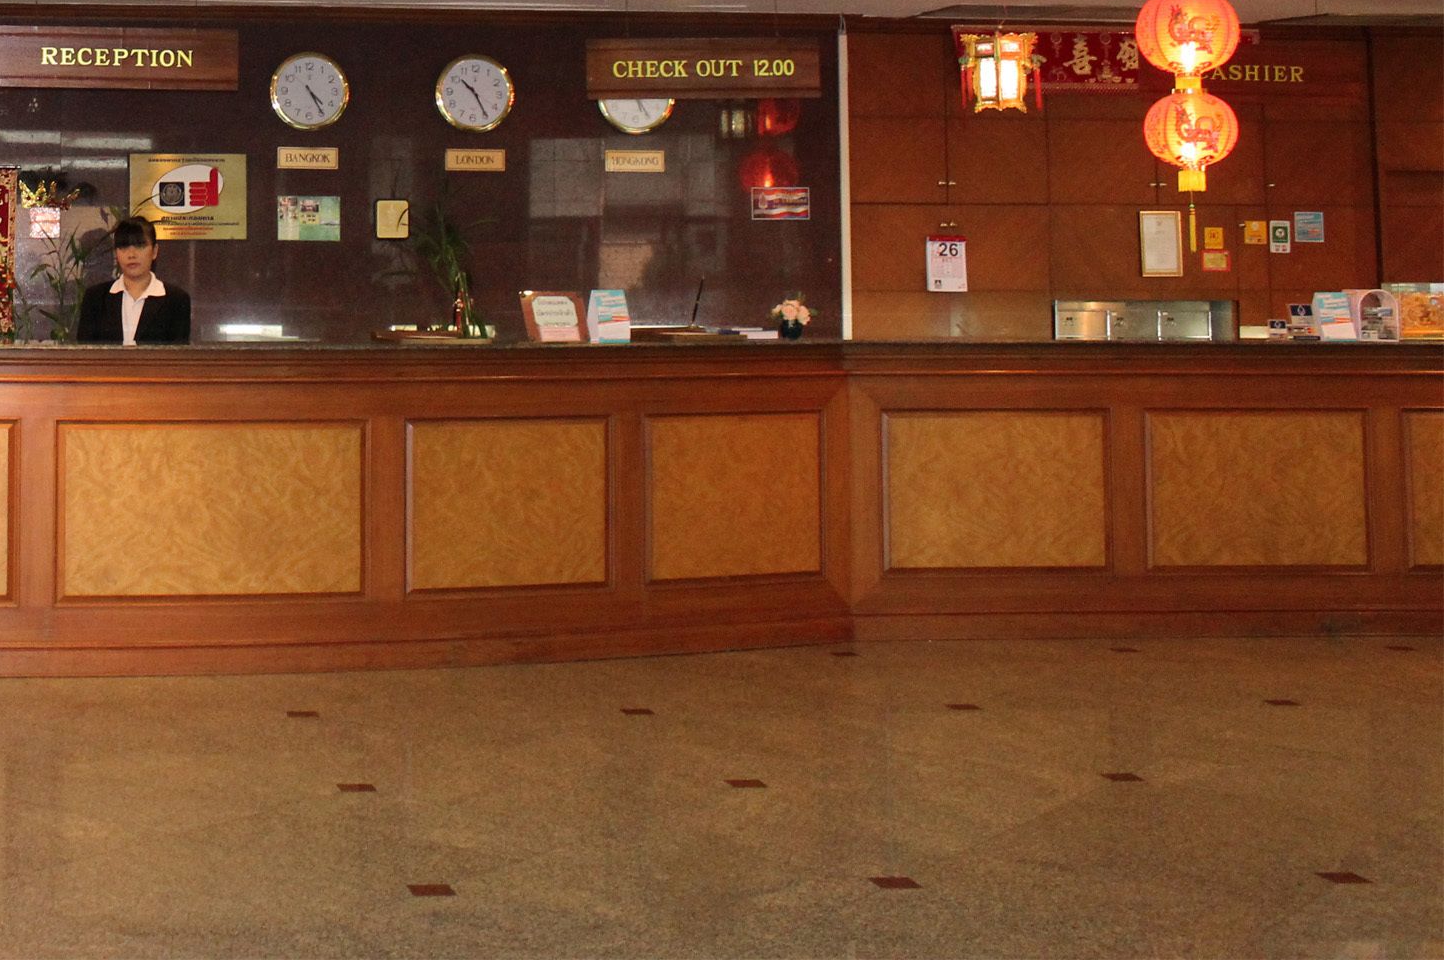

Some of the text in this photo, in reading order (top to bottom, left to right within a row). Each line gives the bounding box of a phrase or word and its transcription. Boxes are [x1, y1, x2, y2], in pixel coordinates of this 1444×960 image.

[41, 46, 193, 68] RECEPTION
[612, 59, 795, 78] CHECK OUT 12.00
[1201, 64, 1304, 82] ASHIER
[285, 153, 330, 163] BANGKOK
[456, 155, 494, 164] LONDON
[939, 242, 958, 257] 26
